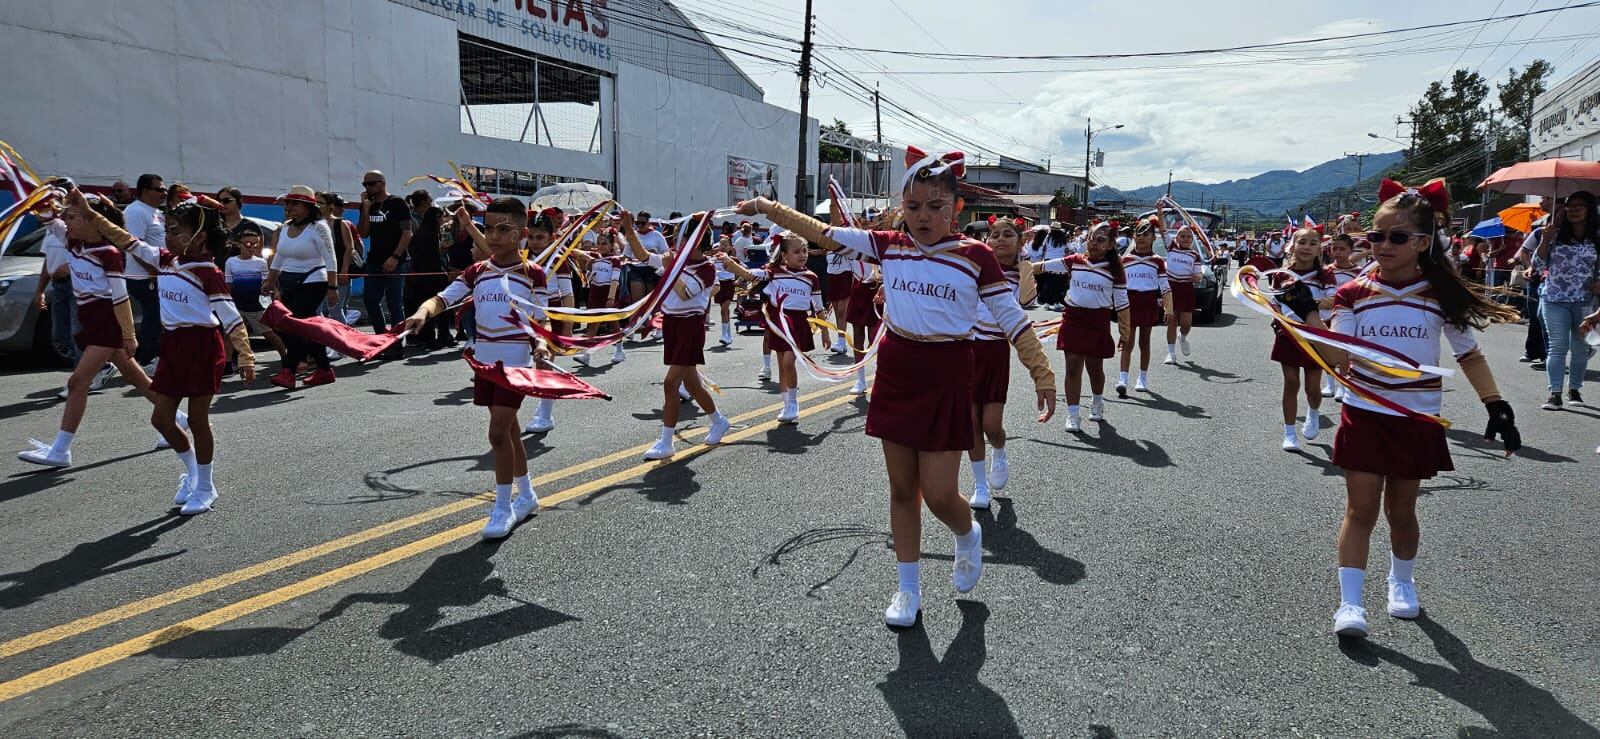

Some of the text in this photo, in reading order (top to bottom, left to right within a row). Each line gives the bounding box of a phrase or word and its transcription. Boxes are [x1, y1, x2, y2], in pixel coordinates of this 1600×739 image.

[486, 8, 506, 28] DE
[521, 18, 612, 61] SOLUCIONES
[1361, 324, 1430, 339] LA GARCÍA
